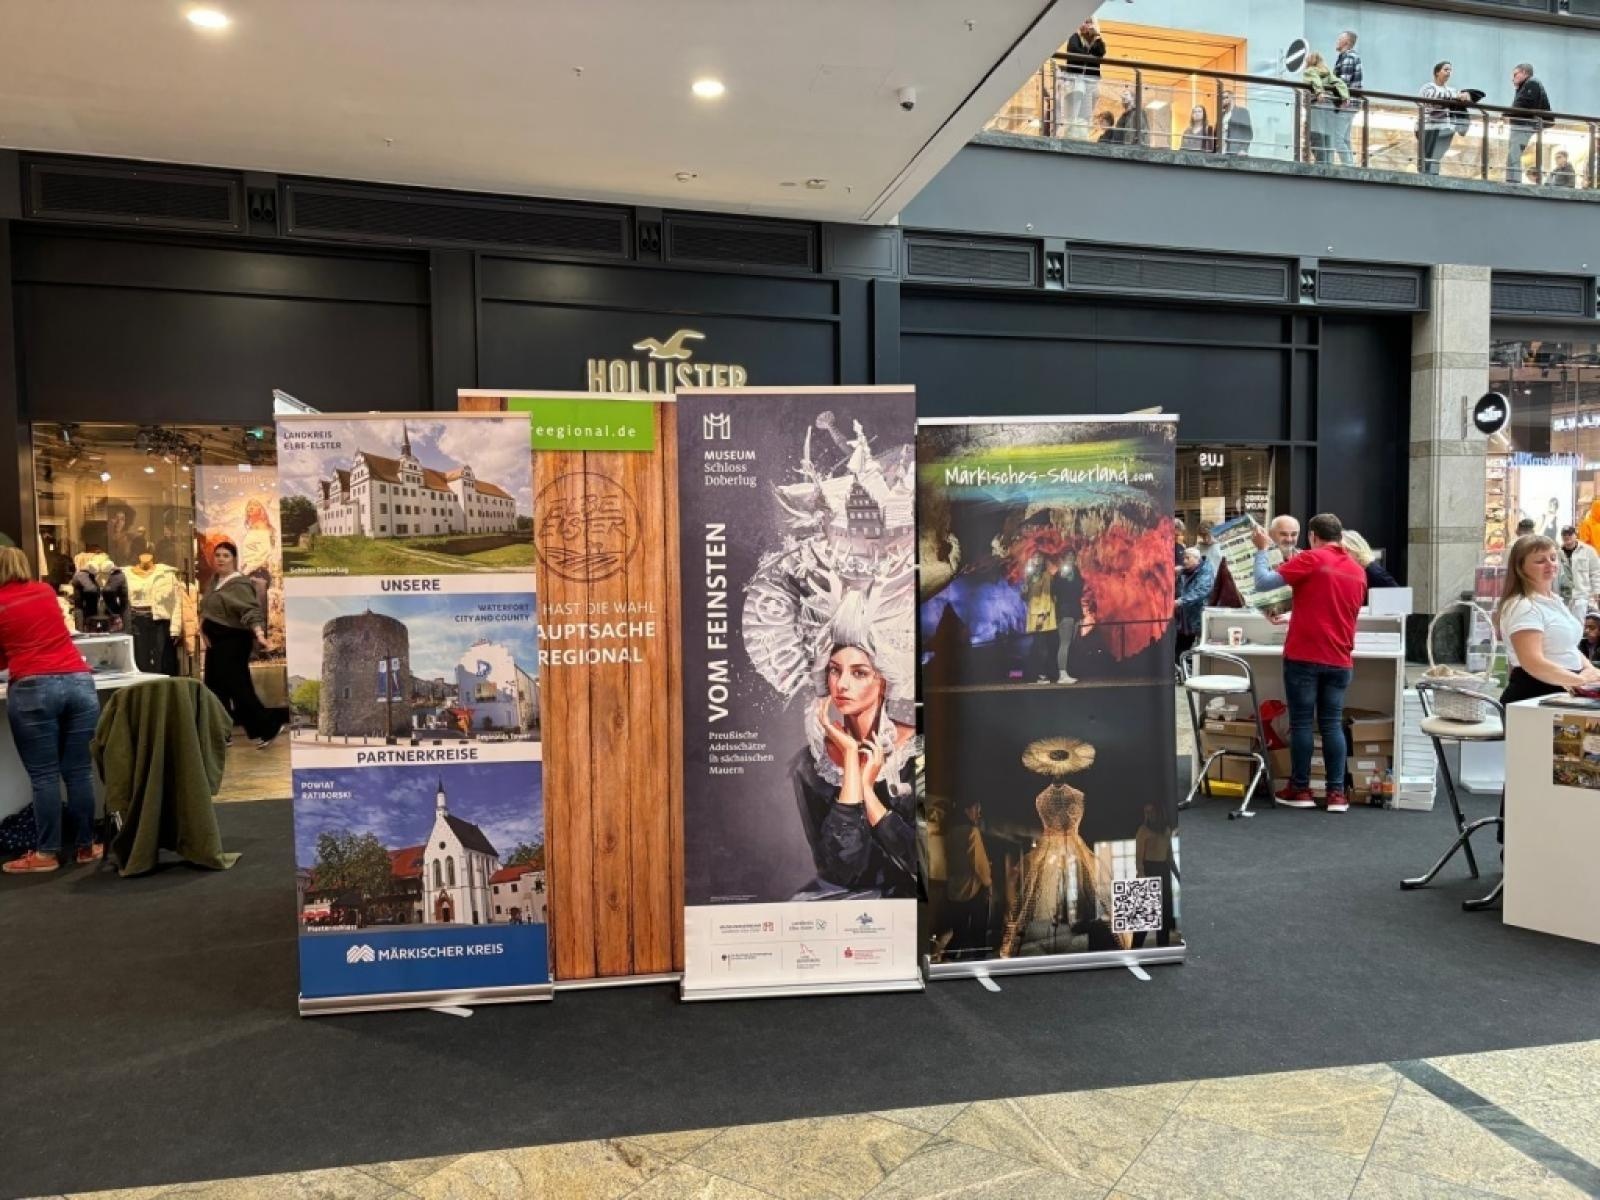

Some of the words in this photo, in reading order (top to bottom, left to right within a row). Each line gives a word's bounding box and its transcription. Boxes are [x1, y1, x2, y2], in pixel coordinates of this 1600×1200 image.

[587, 358, 748, 393] HOLLISTER
[283, 430, 333, 439] LANDKREIS
[532, 423, 637, 439] eegional.de
[283, 441, 342, 450] ELBE-ELSTER
[704, 451, 756, 460] MUSEUM
[704, 462, 748, 473] Schloss
[704, 475, 757, 487] Doberlug
[380, 579, 441, 592] UNSERE
[706, 523, 728, 650] FEINSTEN
[543, 602, 580, 616] HAST
[587, 602, 609, 615] DIE
[613, 602, 656, 615] WAHL
[455, 614, 475, 623] CITY
[475, 614, 496, 622] AND
[495, 613, 530, 623] COUNTY
[537, 621, 656, 640] AUPTSACHE
[538, 647, 643, 666] REGIONAL
[708, 660, 729, 723] VOM
[709, 731, 758, 740] Preußische
[357, 748, 478, 763] PARTNERKREISE
[709, 766, 745, 775] Mauern
[301, 782, 334, 790] POWIAT
[378, 945, 463, 961] MÄRKISCHER
[466, 943, 504, 956] KREIS
